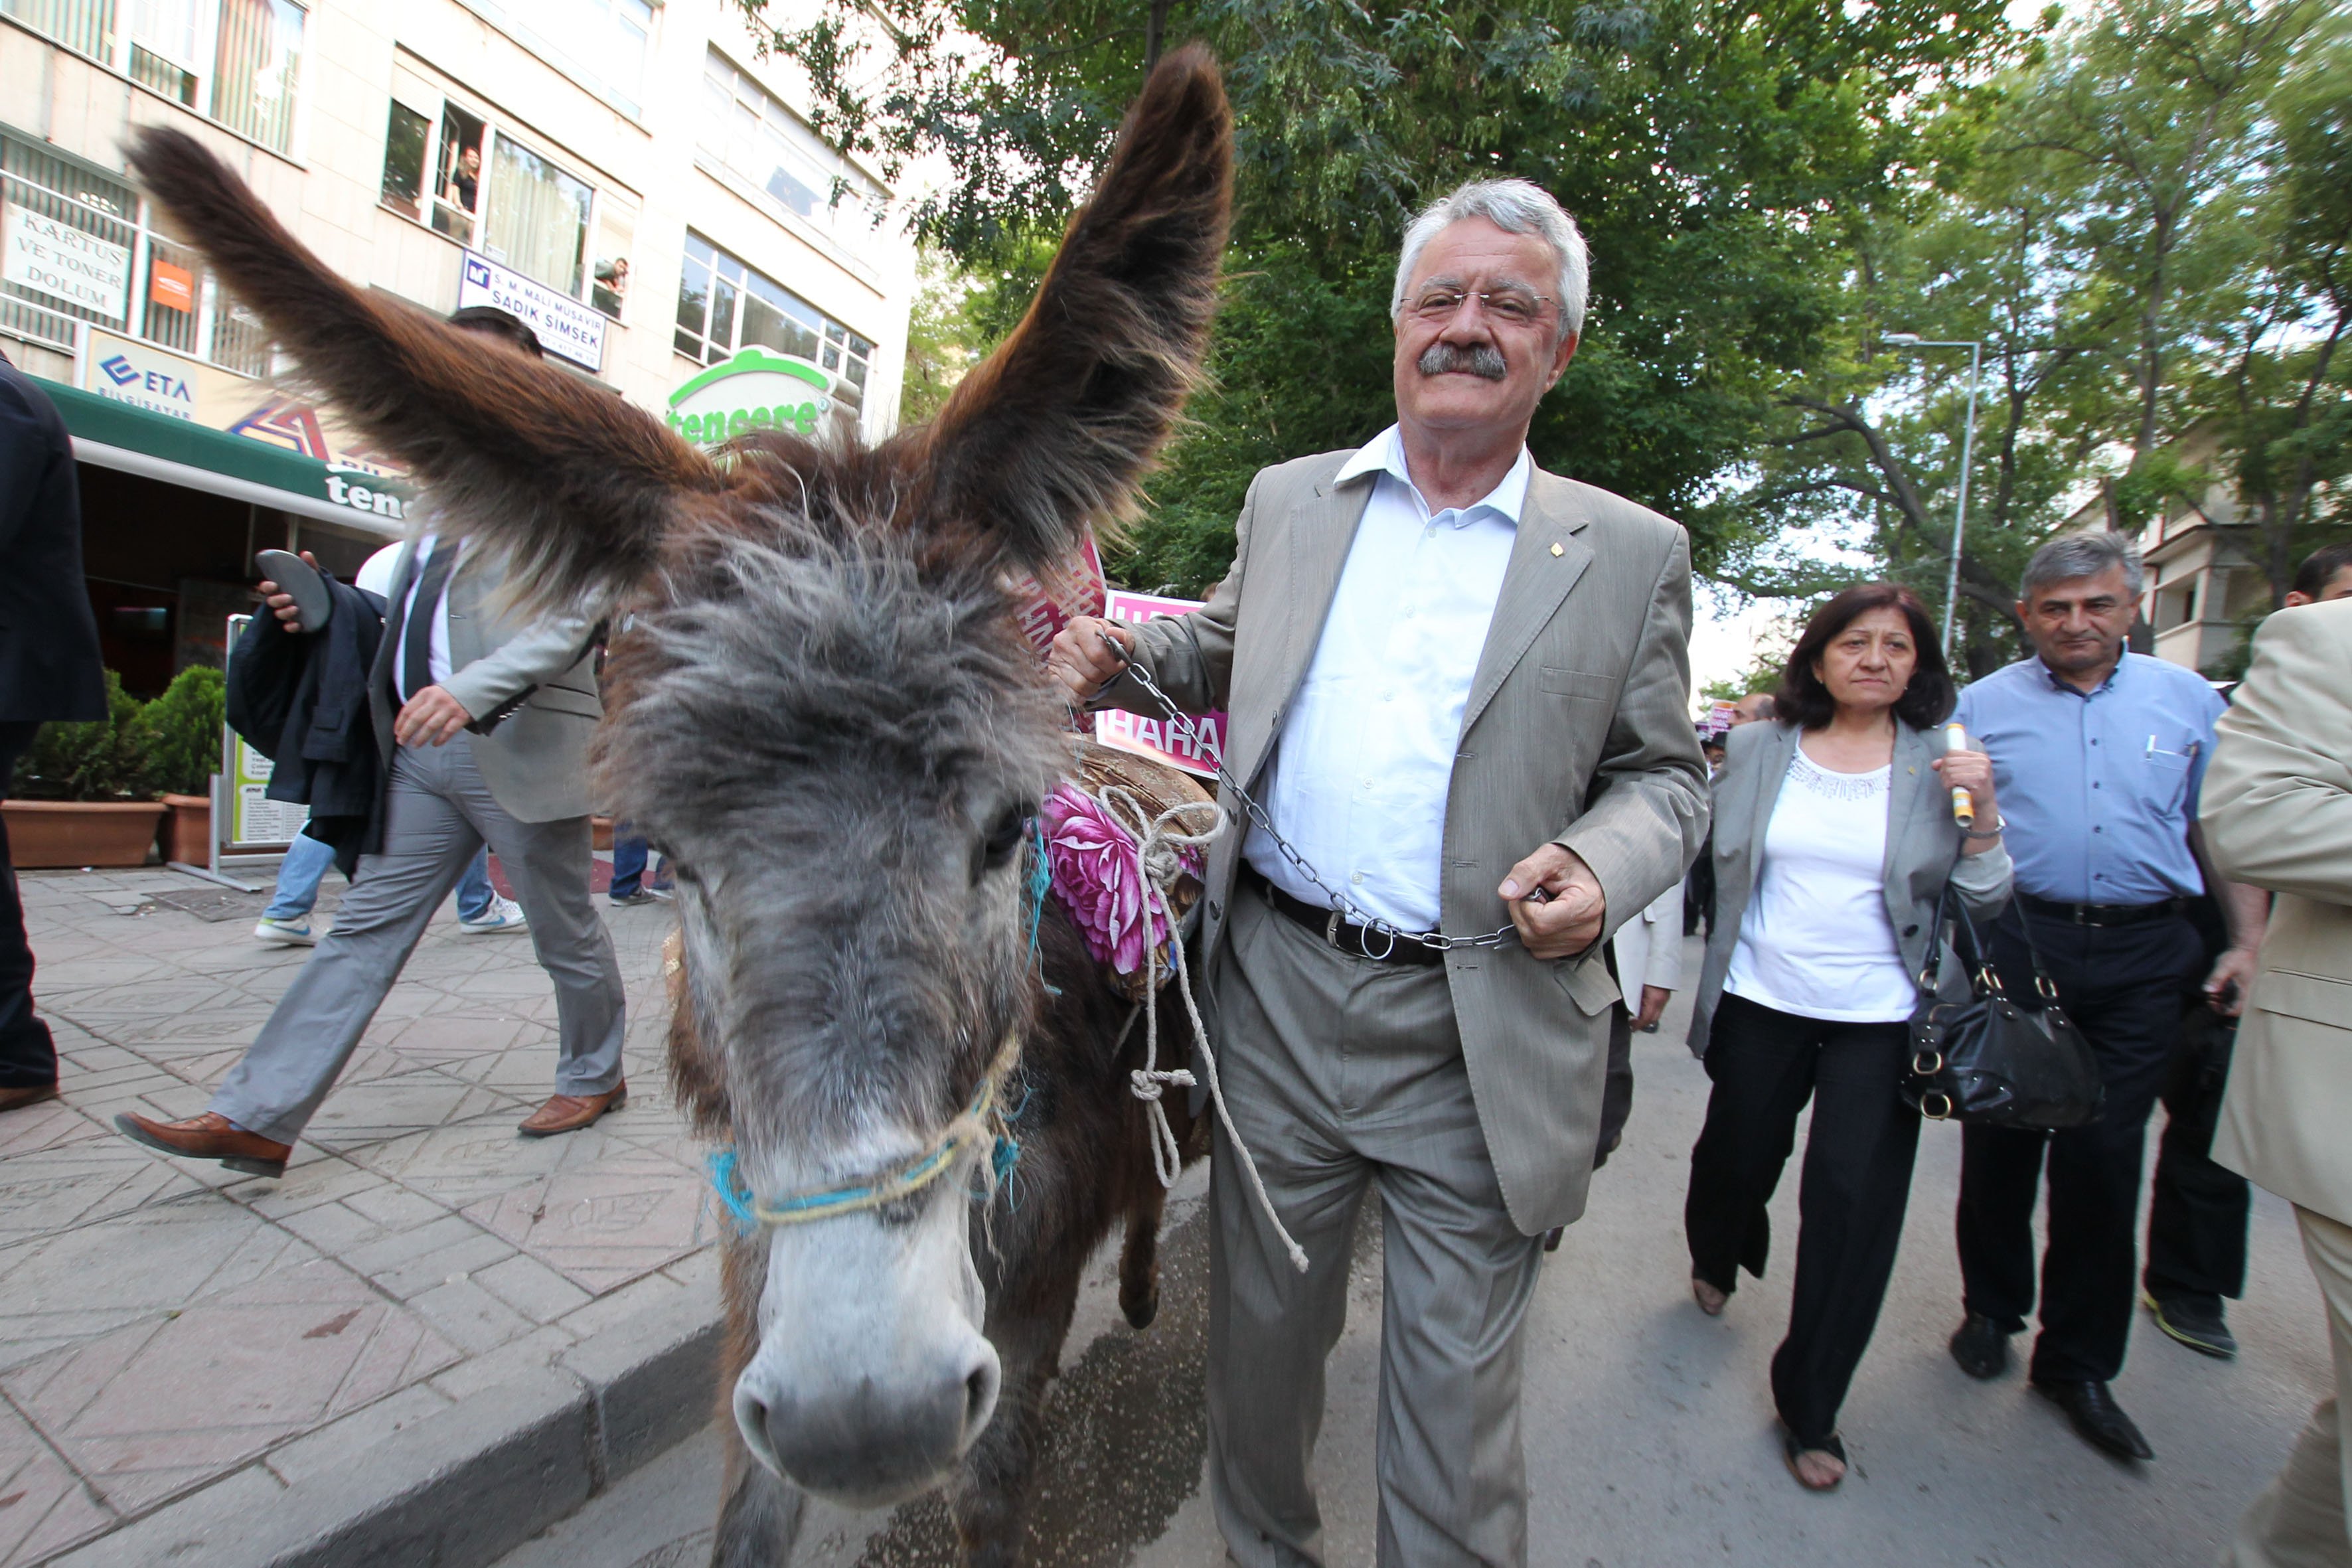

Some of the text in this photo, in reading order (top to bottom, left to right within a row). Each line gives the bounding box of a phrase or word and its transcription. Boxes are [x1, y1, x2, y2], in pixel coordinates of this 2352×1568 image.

[17, 236, 47, 261] VE
[53, 250, 123, 289] TONER
[27, 266, 108, 307] DOLUM
[492, 290, 598, 349] SADIK ŞİMŞEK
[145, 370, 192, 402] ETA
